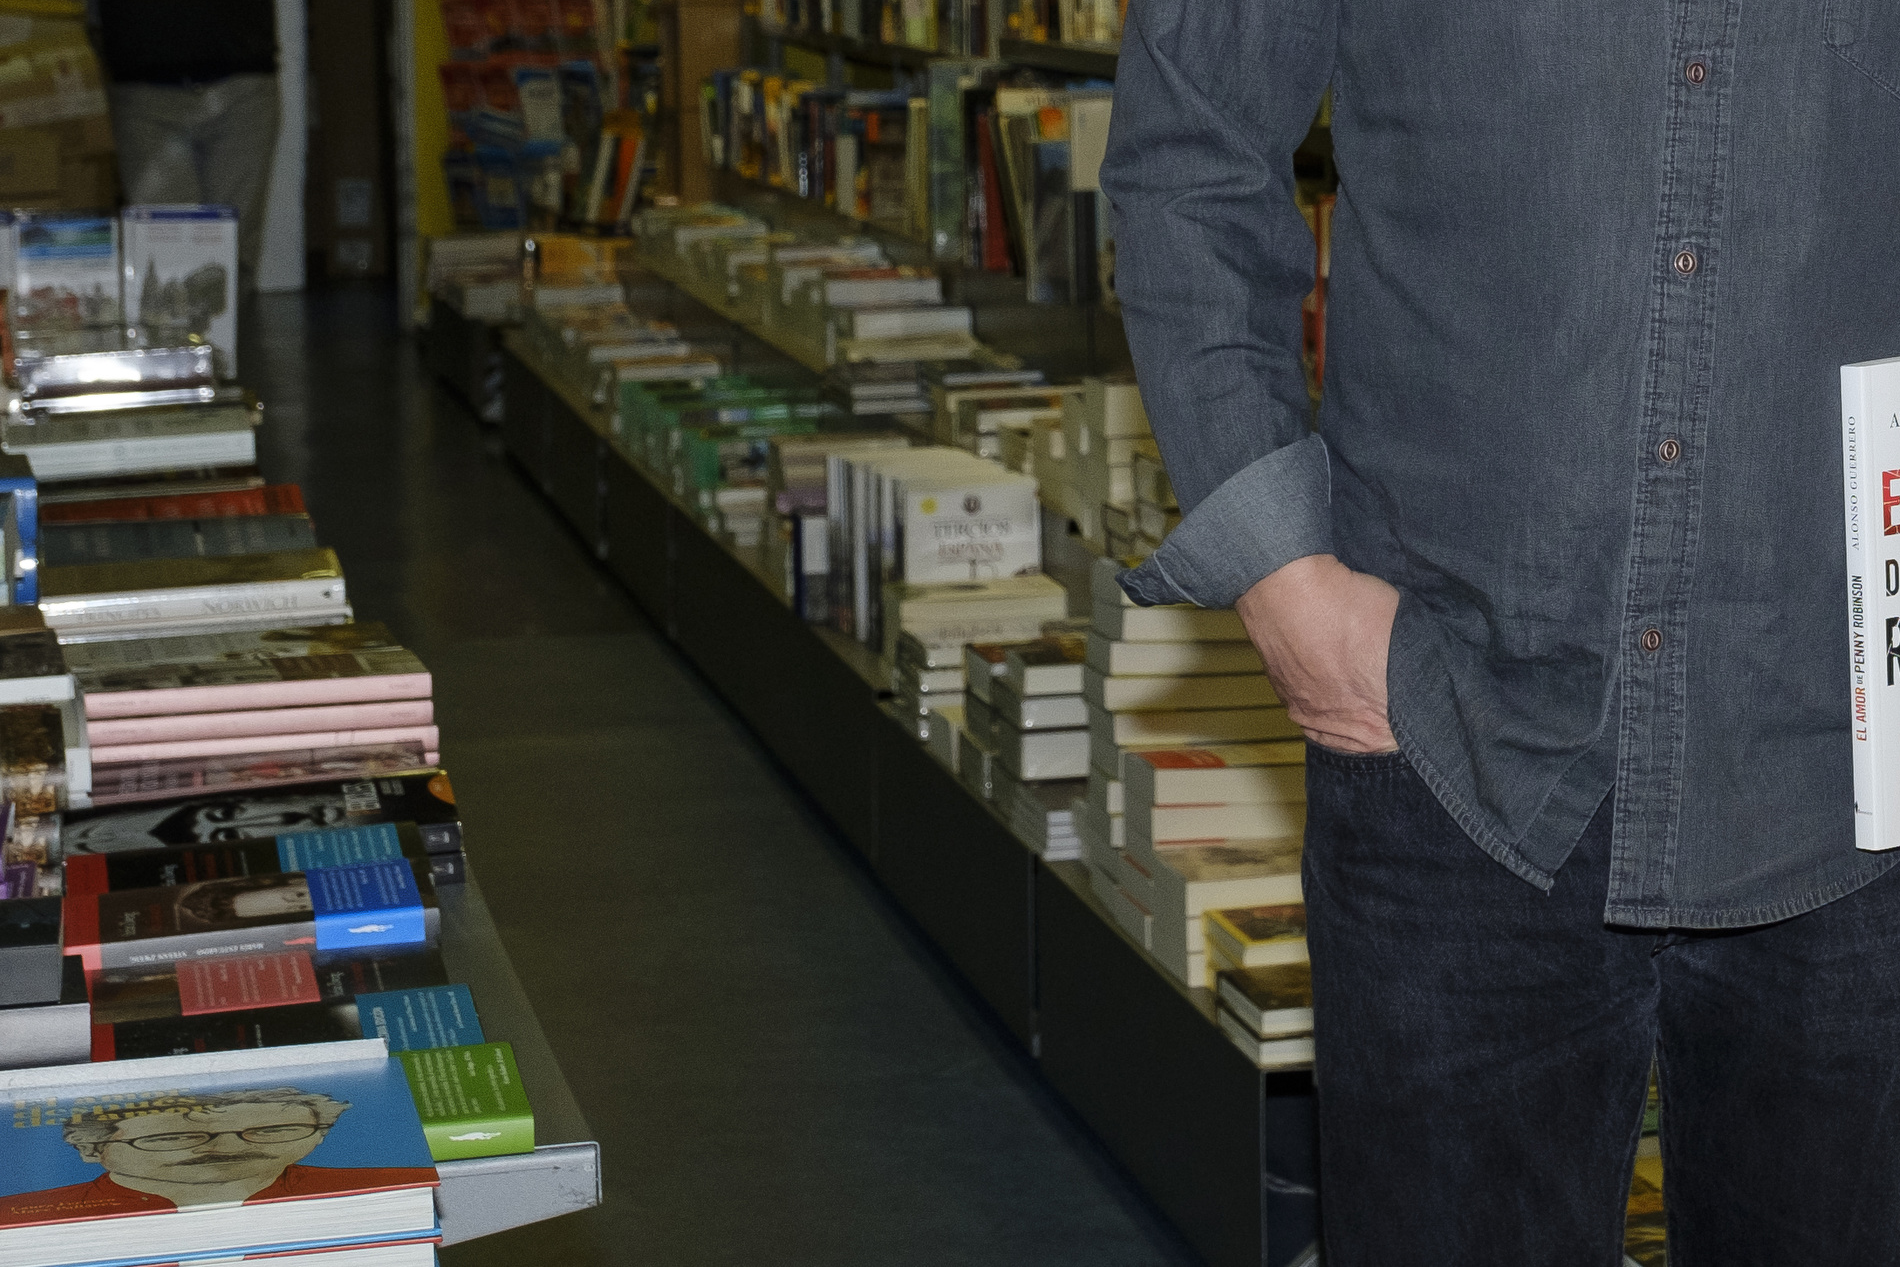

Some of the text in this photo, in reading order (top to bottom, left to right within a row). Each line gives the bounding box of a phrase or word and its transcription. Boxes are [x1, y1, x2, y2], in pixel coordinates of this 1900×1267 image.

[1847, 415, 1860, 551] ALONSO GUERRERO
[1852, 575, 1863, 630] ROBINSON
[1854, 631, 1866, 675] PENNY
[1855, 687, 1867, 724] AMOR
[1856, 726, 1867, 742] EL
